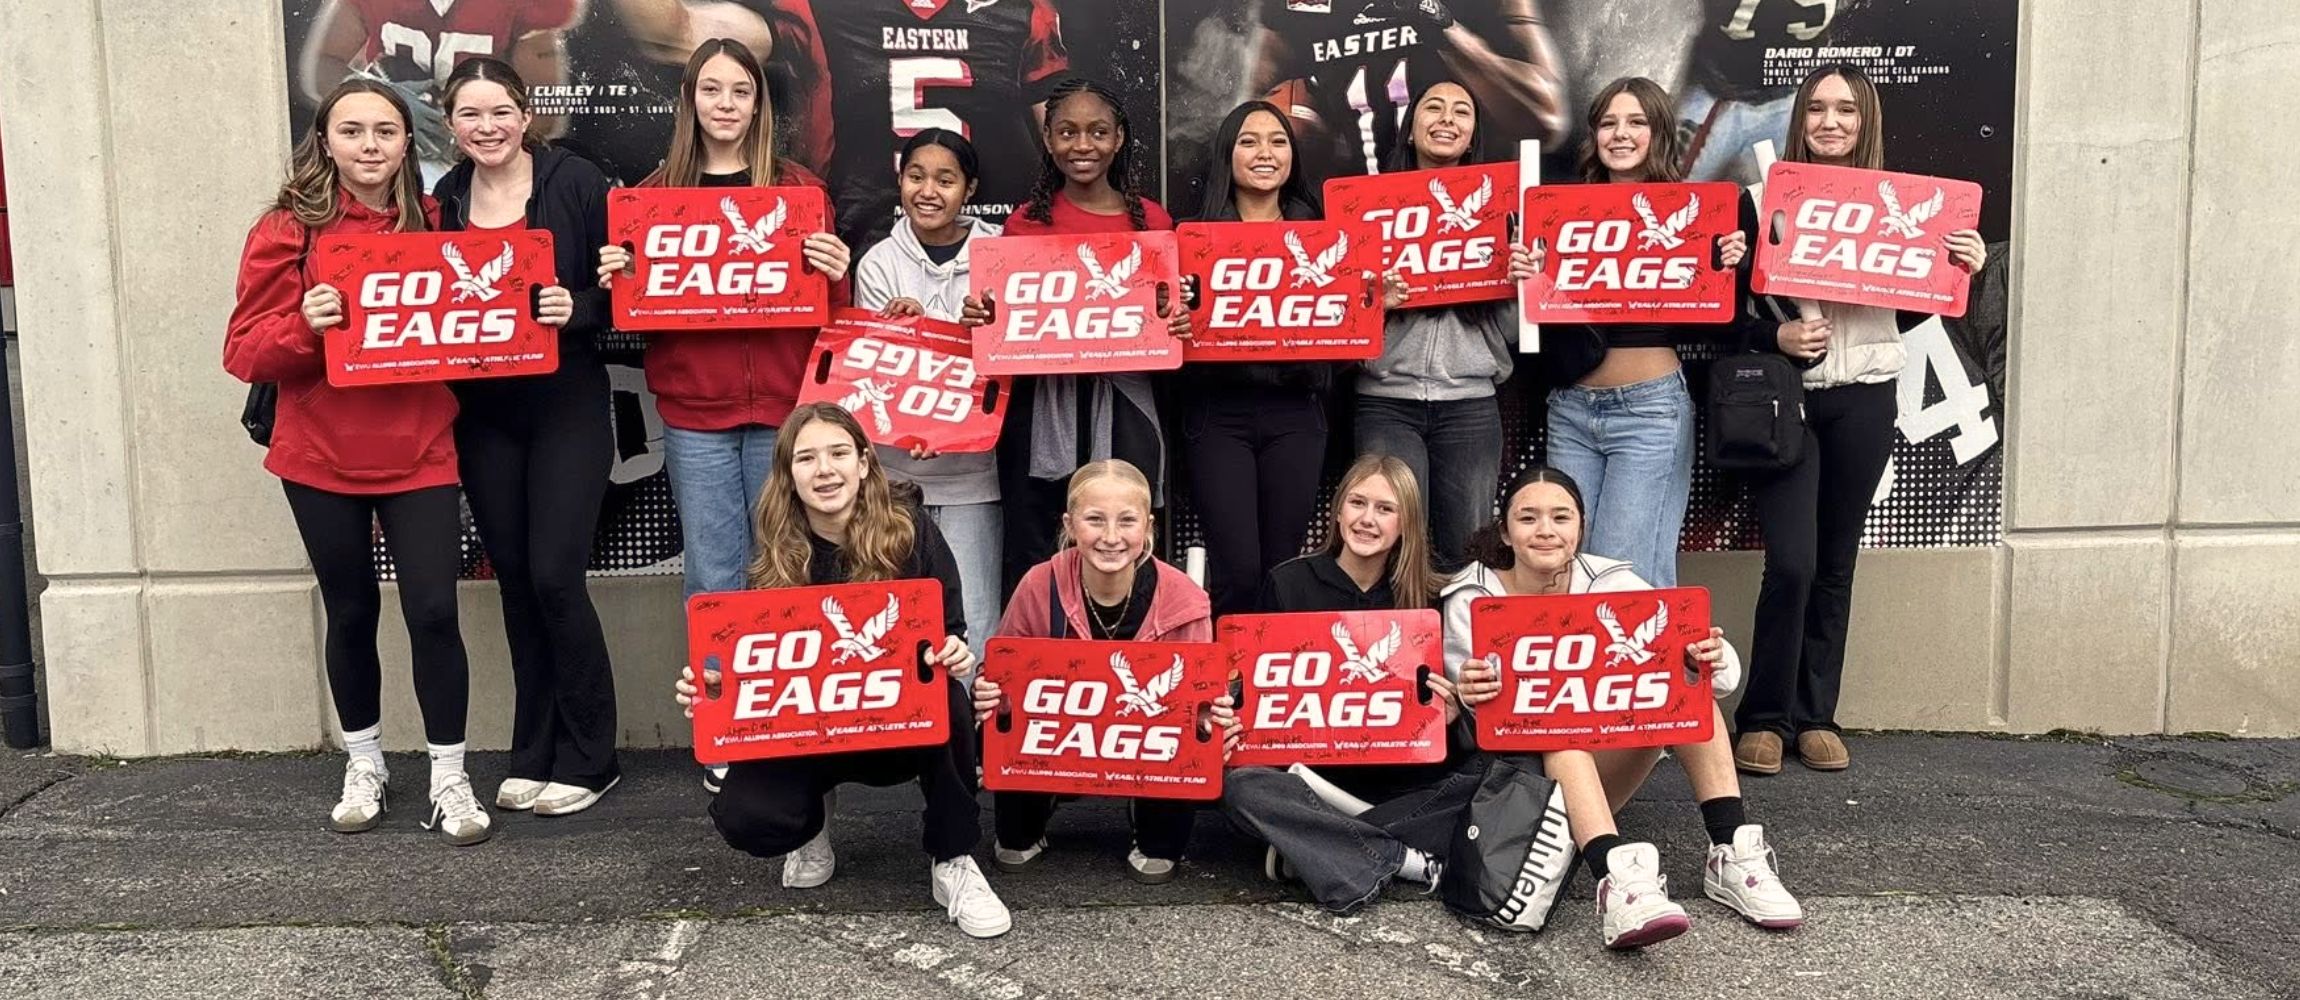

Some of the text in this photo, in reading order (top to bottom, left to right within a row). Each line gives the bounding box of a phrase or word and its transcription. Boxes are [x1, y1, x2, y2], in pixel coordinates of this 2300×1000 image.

[882, 27, 969, 50] EASTERN
[1765, 47, 1813, 59] DARIO
[1817, 46, 1882, 58] ROMERO
[1895, 45, 1916, 57] DT
[1911, 66, 1950, 74] SEASONS
[534, 85, 596, 97] CURLEY
[608, 84, 627, 96] TE
[1795, 198, 1874, 234] GO
[644, 224, 721, 258] GO
[1556, 220, 1631, 253] GO
[1381, 236, 1495, 275] AGS
[1789, 234, 1936, 279] EAGS
[359, 270, 443, 308] GO
[645, 261, 790, 297] EAGS
[1004, 270, 1078, 304] GO
[1210, 257, 1284, 291] GO
[1553, 257, 1698, 291] EAGS
[360, 308, 517, 349] EAGS
[1004, 306, 1144, 341] EAGS
[1209, 294, 1348, 328] EAGS
[843, 338, 977, 389] EAGS
[898, 385, 973, 423] GO
[1897, 313, 1998, 466] 4
[732, 629, 822, 674] GO
[1253, 651, 1332, 687] GO
[1512, 634, 1597, 672] GO
[733, 669, 903, 720] EAGS
[1023, 679, 1108, 716] GO
[1253, 691, 1403, 729] EAGS
[1512, 671, 1671, 714] EAGS
[836, 726, 864, 734] EAGLE
[909, 720, 933, 728] FUND
[1020, 719, 1182, 761] EAGS
[1370, 740, 1408, 748] ATHLETIC
[1548, 726, 1593, 735] ASSOCIATION
[1609, 725, 1635, 733] EAGLE
[1183, 776, 1206, 784] FUND
